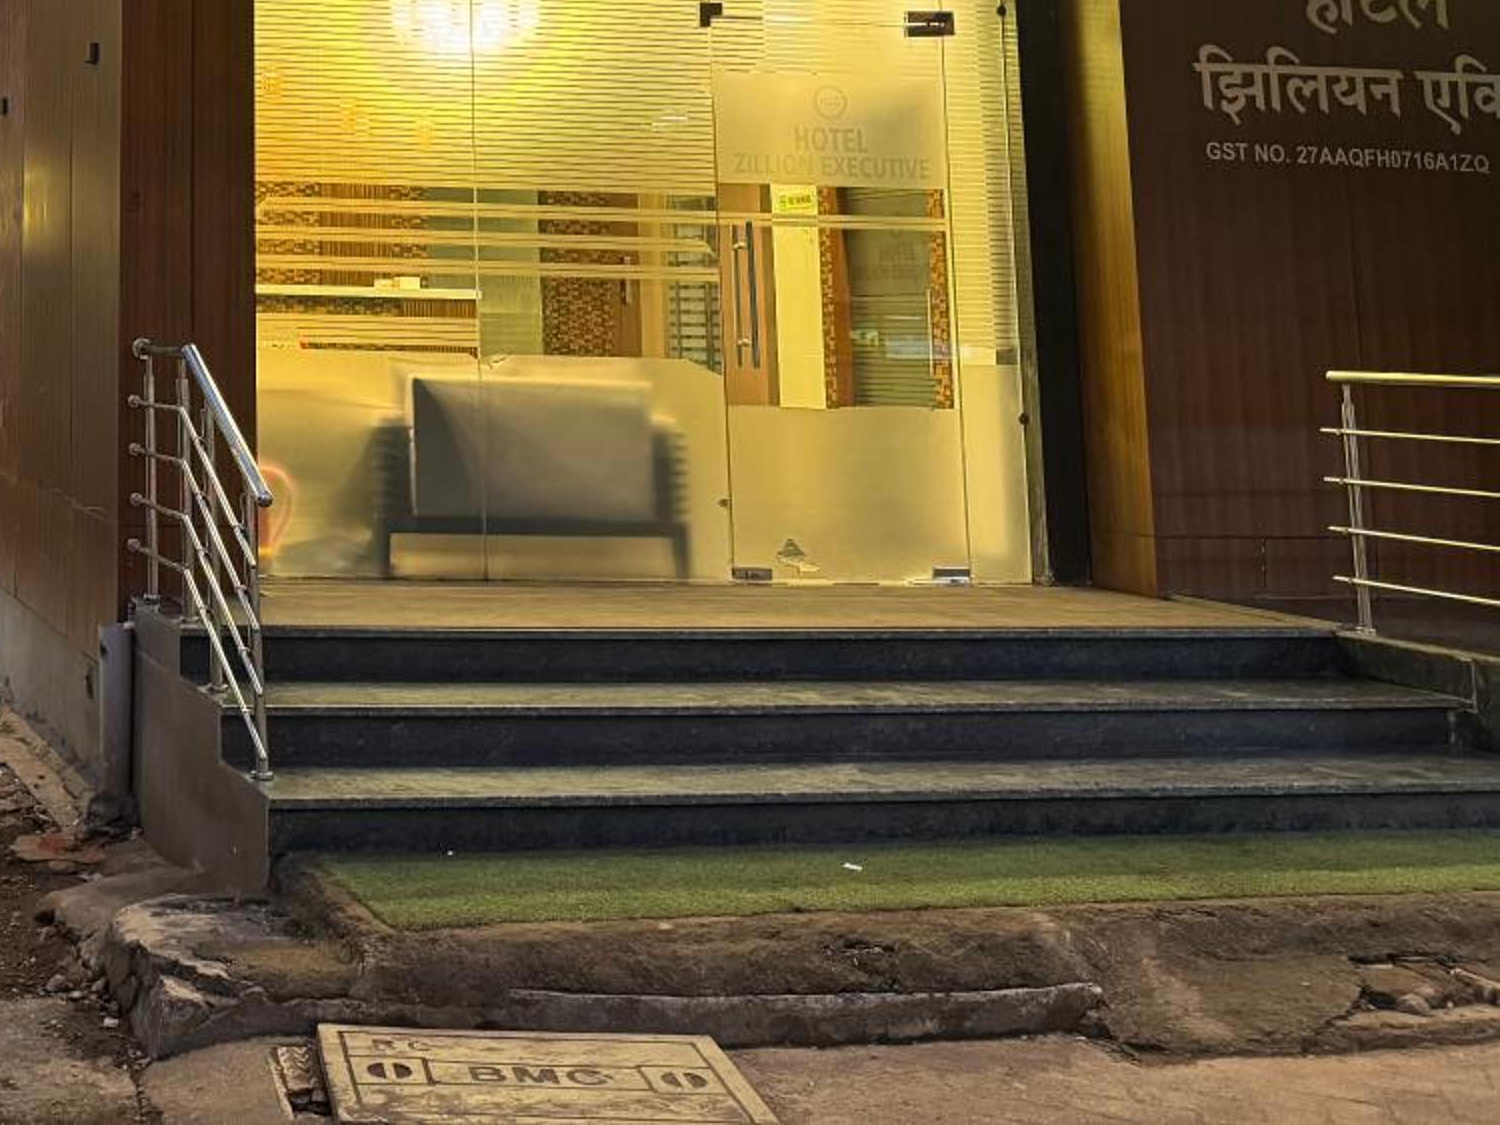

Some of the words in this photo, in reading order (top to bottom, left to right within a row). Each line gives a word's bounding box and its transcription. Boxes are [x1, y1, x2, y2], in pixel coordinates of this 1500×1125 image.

[1192, 43, 1403, 126] झिलियन
[794, 125, 869, 154] HOTEL
[733, 152, 815, 175] ZILLION
[820, 155, 932, 181] EXECUTIVE
[1205, 141, 1248, 161] GST
[1255, 143, 1290, 164] NO.
[1297, 145, 1490, 174] 27AAQFH0716A1ZQ
[467, 1066, 615, 1087] BMC
